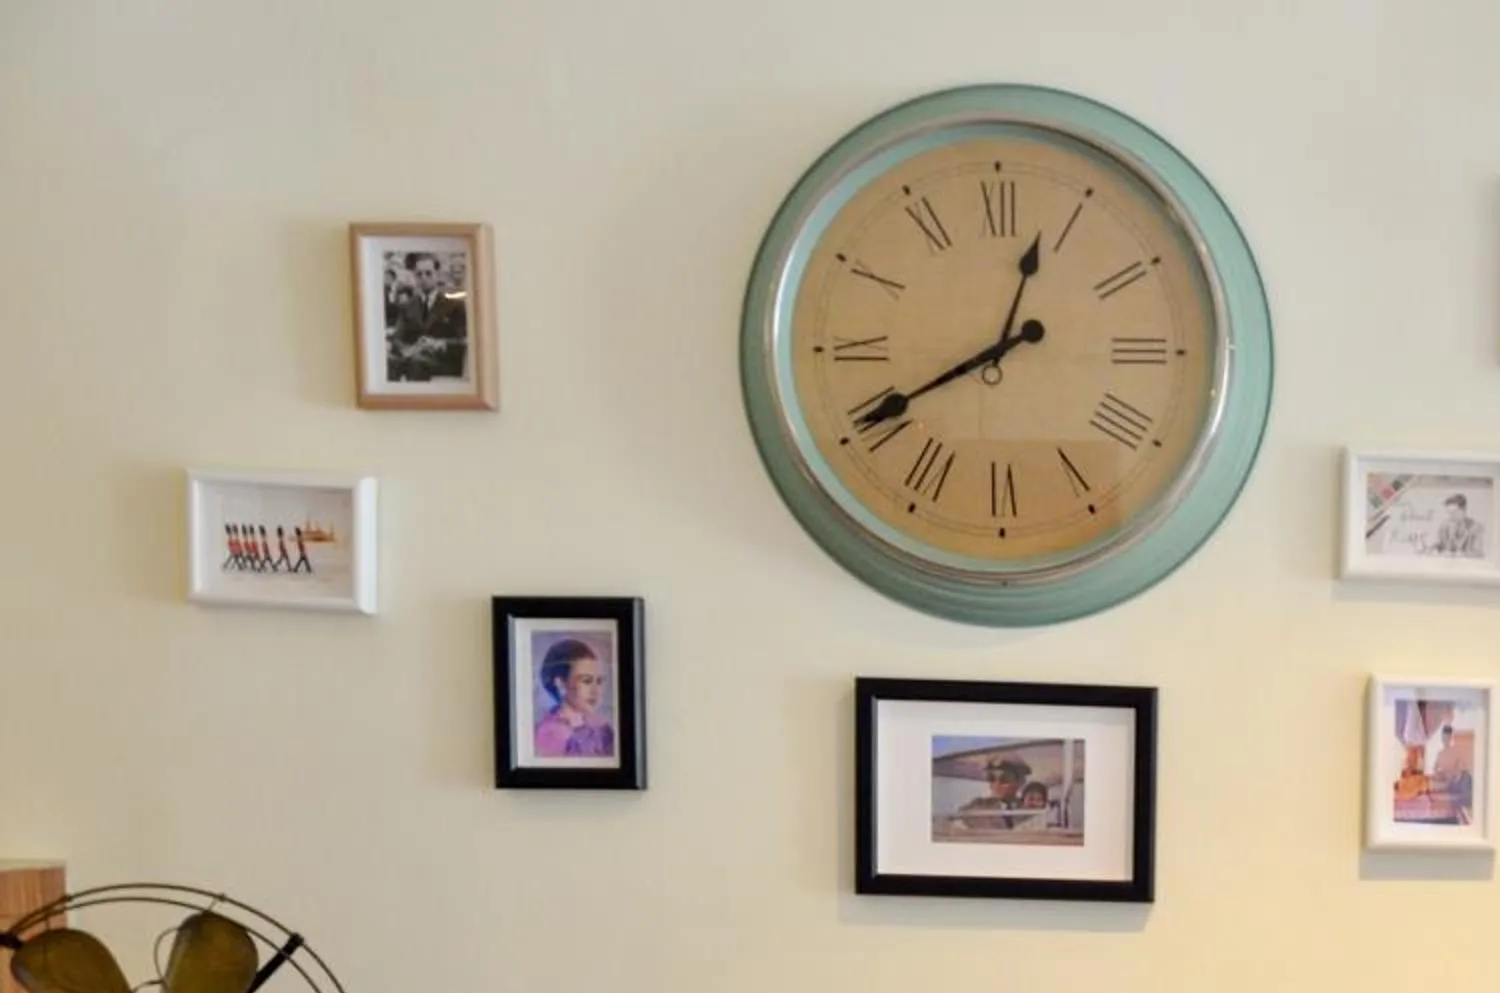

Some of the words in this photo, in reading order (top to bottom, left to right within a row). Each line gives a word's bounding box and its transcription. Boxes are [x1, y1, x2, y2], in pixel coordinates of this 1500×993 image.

[903, 197, 953, 256] XI
[979, 180, 1017, 238] XII
[1053, 203, 1083, 253] I
[850, 259, 906, 299] X
[1093, 260, 1148, 299] II
[833, 335, 890, 362] IX
[1111, 337, 1168, 364] III
[905, 437, 956, 503] VII
[991, 461, 1018, 517] VI
[1057, 447, 1090, 498] V
